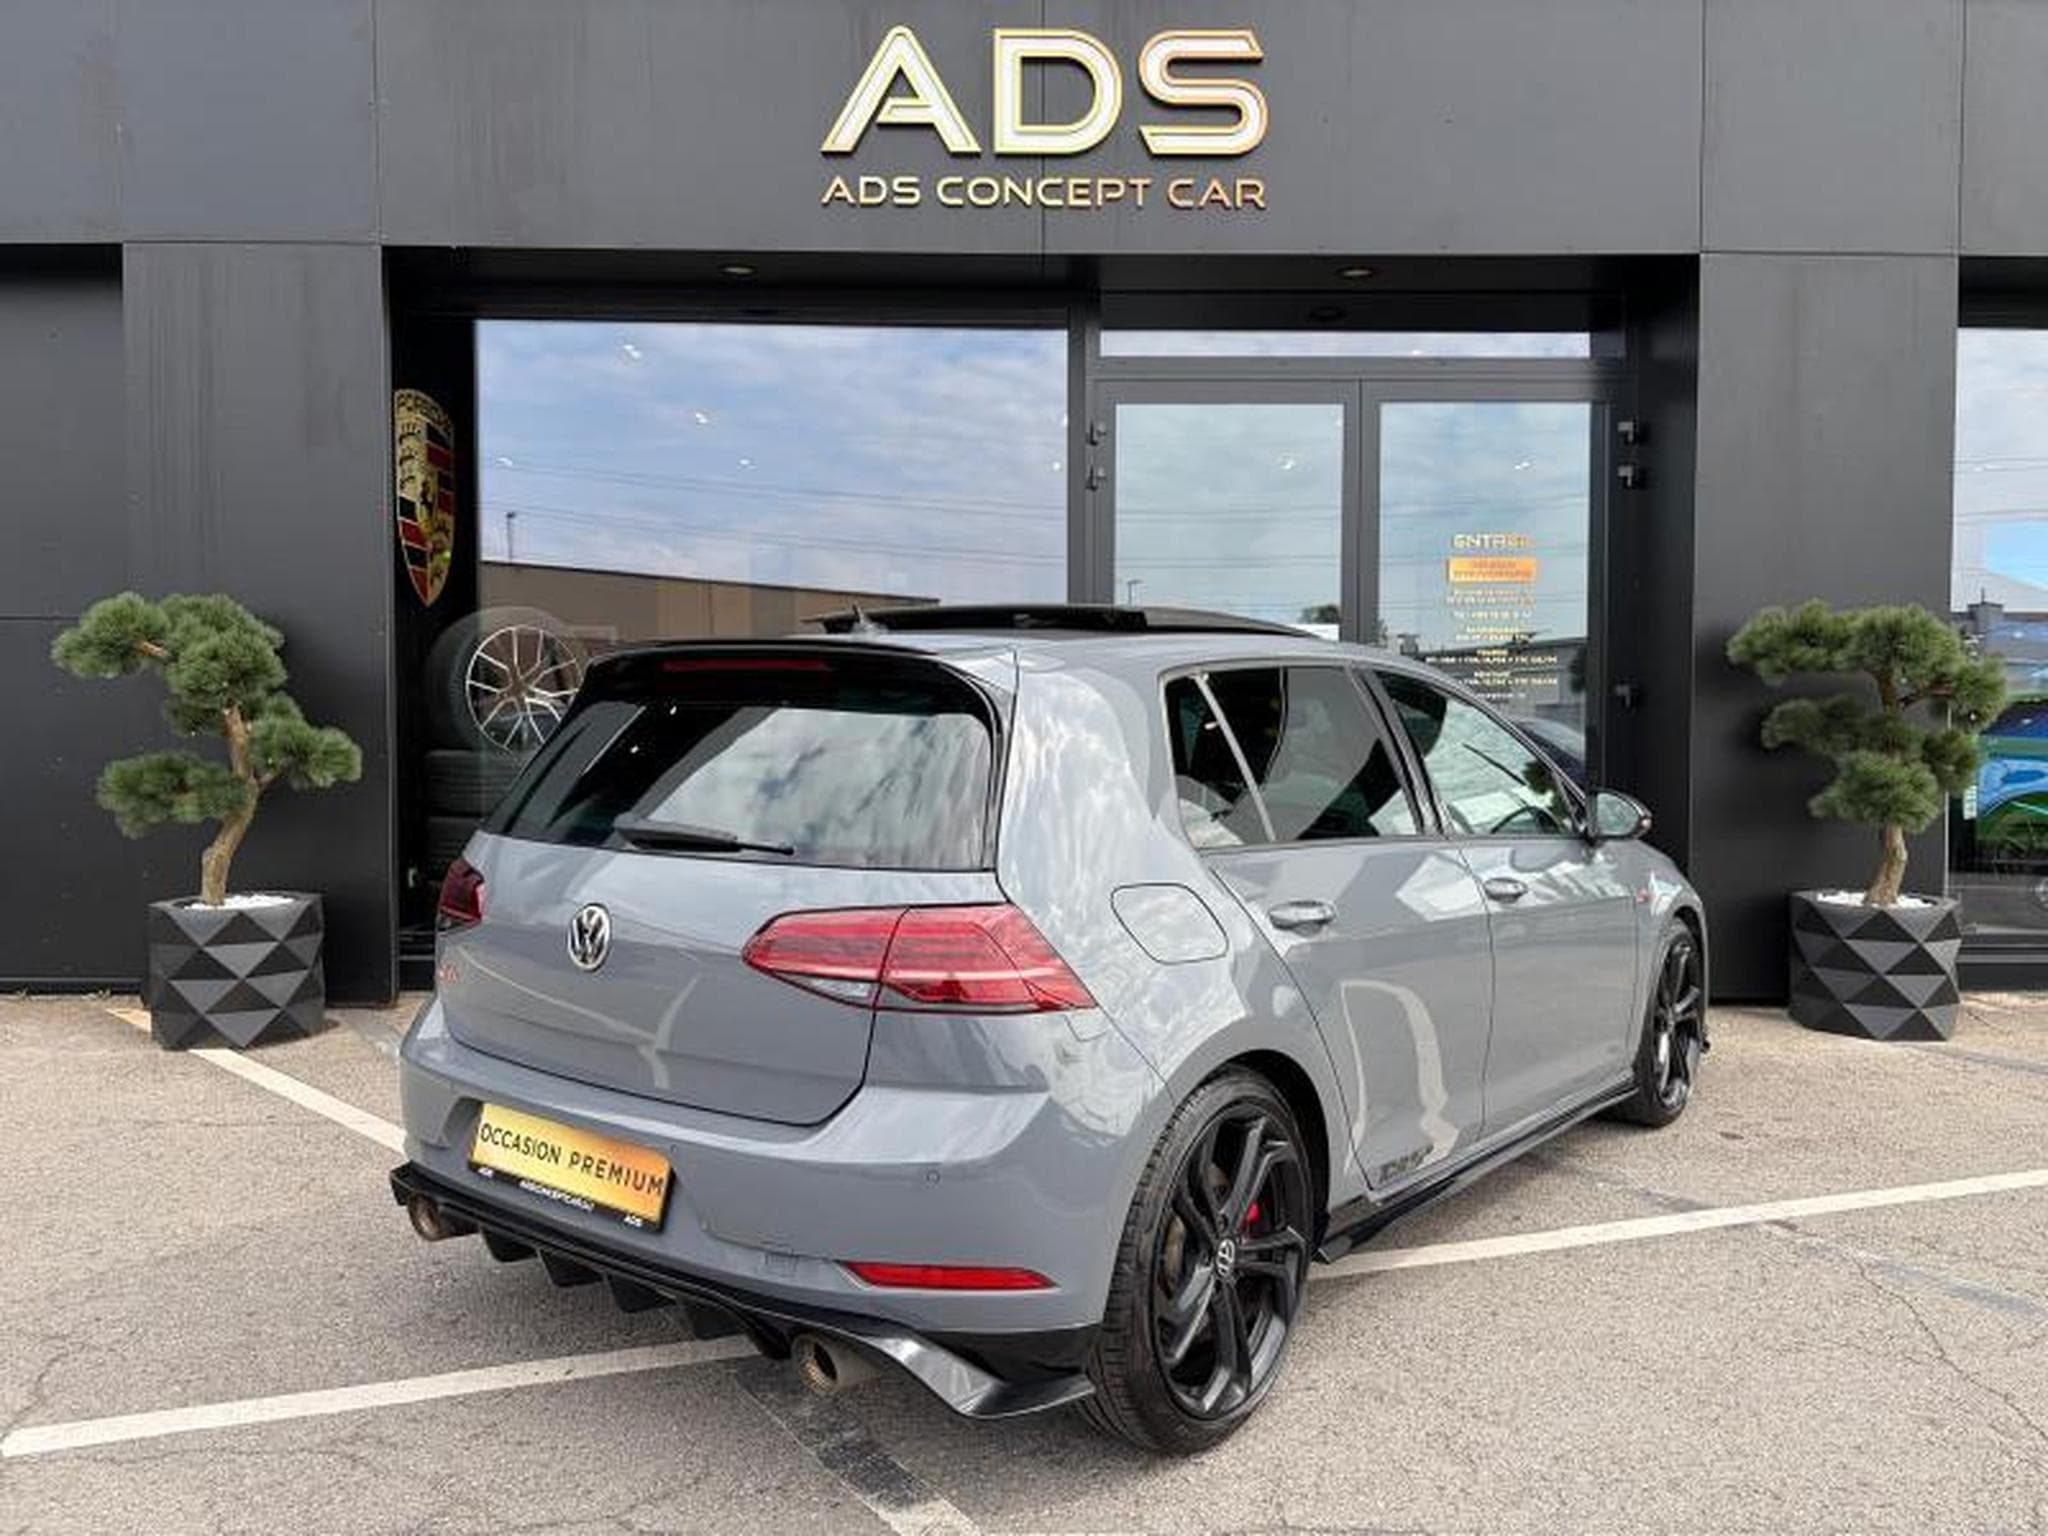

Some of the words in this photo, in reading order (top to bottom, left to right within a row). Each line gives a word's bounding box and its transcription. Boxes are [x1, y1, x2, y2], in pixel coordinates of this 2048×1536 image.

[820, 25, 1269, 155] ADS
[820, 176, 922, 206] ADS
[936, 176, 1152, 207] CONCEPT
[1166, 177, 1267, 208] CAR
[1453, 533, 1534, 550] ENTR
[480, 1122, 562, 1166] OCCASION
[568, 1150, 666, 1196] PREMIUM
